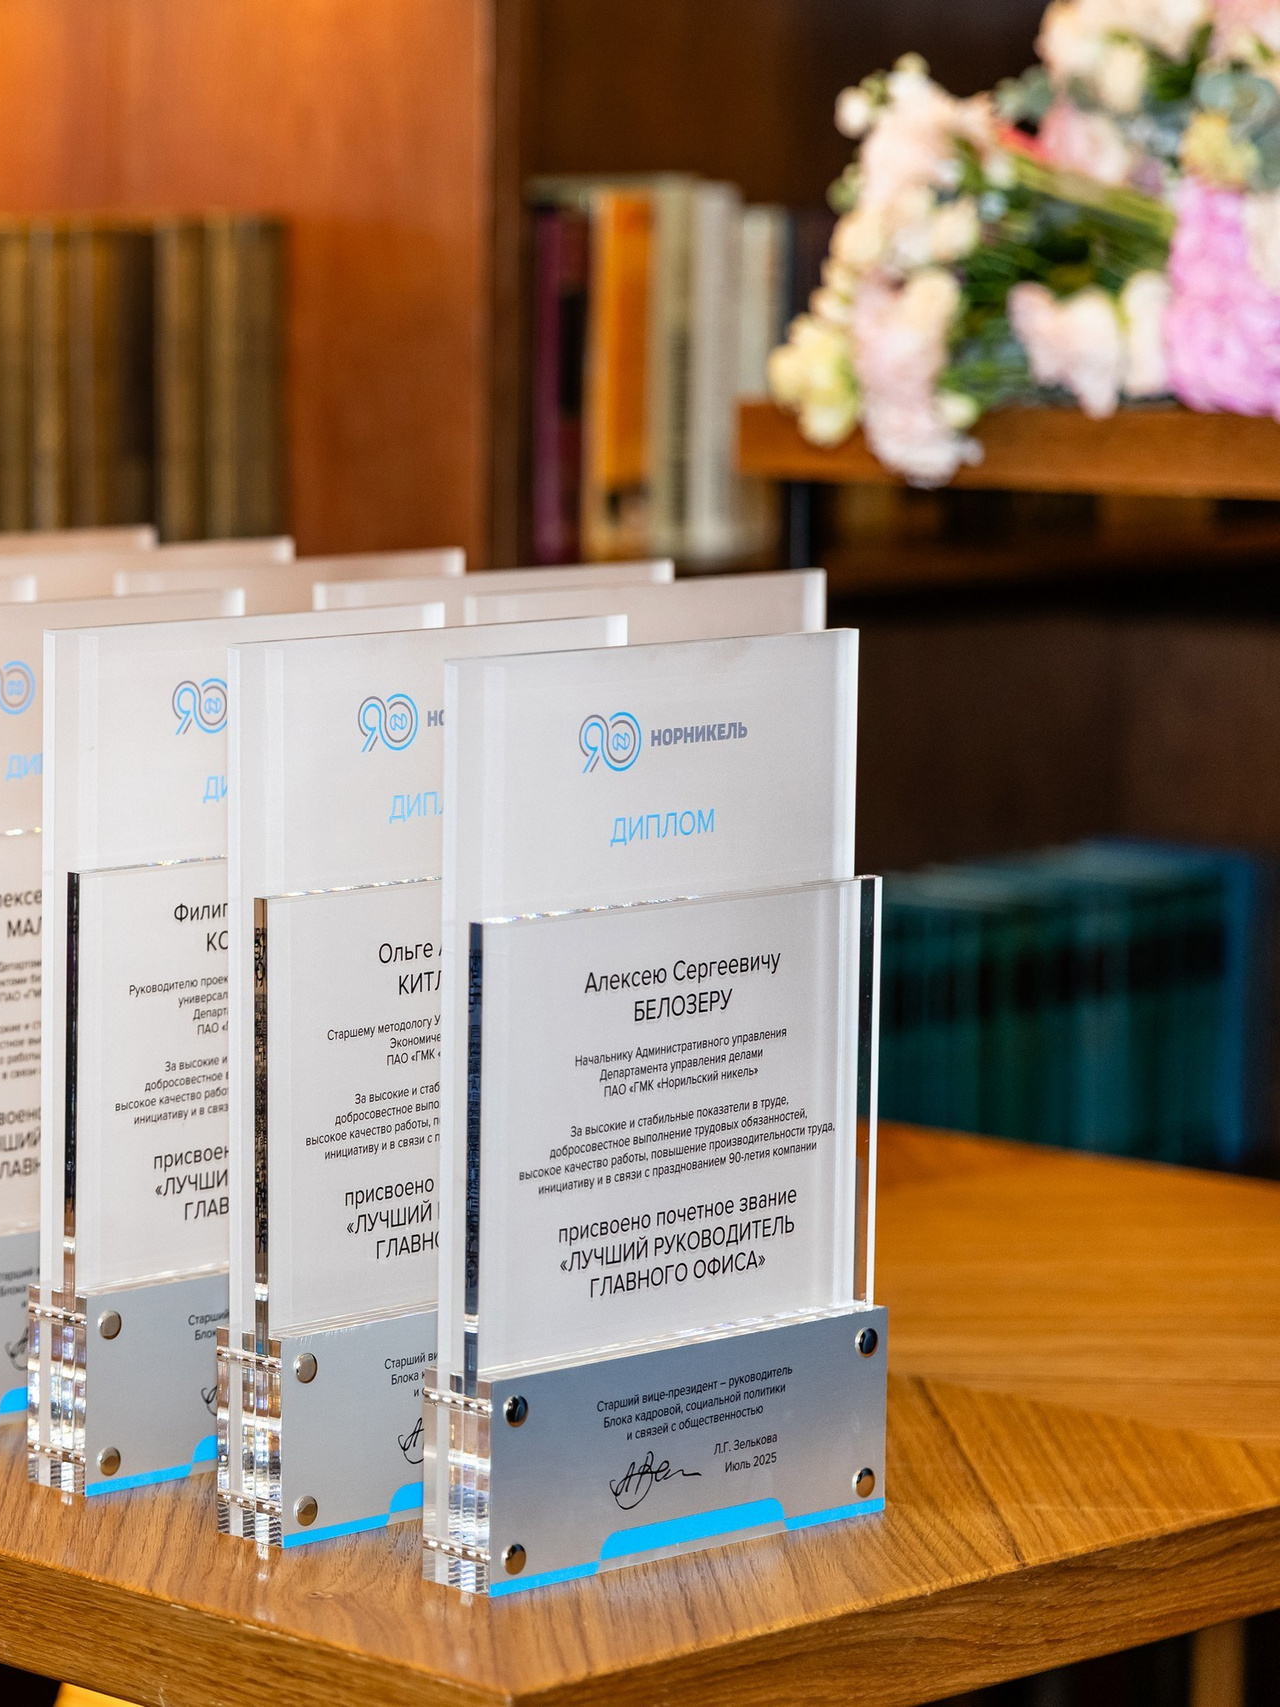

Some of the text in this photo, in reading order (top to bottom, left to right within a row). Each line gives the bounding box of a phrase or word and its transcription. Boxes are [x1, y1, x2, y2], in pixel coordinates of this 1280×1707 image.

[650, 721, 748, 747] НОРНИКЕЛЬ
[389, 791, 443, 824] ДИП
[609, 808, 715, 847] ДИПЛОМ
[379, 943, 433, 963] Ольге
[585, 954, 780, 992] Алексею Сергеевичу
[129, 979, 198, 996] Руководителю
[179, 991, 228, 1007] универсал
[635, 989, 732, 1021] БЕЛОЗЕРУ
[197, 1022, 219, 1034] ПАО
[327, 1019, 432, 1041] Старшему методологу
[387, 1049, 435, 1065] ПАО «ГМК
[575, 1029, 786, 1066] Начальнику Административного управления
[165, 1062, 176, 1071] За
[179, 1057, 219, 1069] высокие
[600, 1050, 763, 1081] Департамента управления делами
[145, 1073, 223, 1092] добросовестное
[604, 1068, 758, 1096] ПАО «ГМК «Норильский никель»
[115, 1099, 156, 1111] высокое
[159, 1092, 202, 1105] качество
[355, 1094, 366, 1104] За
[369, 1089, 409, 1102] высокие
[134, 1110, 188, 1124] инициативу
[335, 1105, 412, 1125] добросовестное
[571, 1096, 788, 1137] За высокие и стабильные показатели в труде,
[306, 1119, 430, 1145] высокое качество работы,
[550, 1108, 807, 1159] добросовестное выполнение трудовых обязанностей,
[325, 1144, 379, 1159] инициативу
[398, 1137, 424, 1148] связи
[427, 1135, 432, 1143] с
[519, 1123, 835, 1180] высокое качество работы, повышение производительности труда,
[539, 1179, 594, 1193] инициативу
[606, 1175, 611, 1184] в
[614, 1171, 642, 1181] связи
[645, 1169, 649, 1177] с
[653, 1157, 726, 1178] празднованием
[729, 1150, 770, 1163] 90-летия
[773, 1142, 816, 1156] компании
[156, 1169, 228, 1196] «ЛУЧШИ
[346, 1179, 434, 1209] присвоено
[185, 1197, 229, 1219] ГЛАВ
[347, 1200, 431, 1233] «ЛУЧШИЙ
[559, 1190, 796, 1245] присвоено почетное звание
[561, 1216, 794, 1271] «ЛУЧШИЙ РУКОВОДИТЕЛЬ
[591, 1251, 765, 1297] ГЛАВНОГО ОФИСА»
[385, 1353, 425, 1369] Старший
[392, 1373, 419, 1385] Блока
[597, 1395, 639, 1412] Старший
[642, 1381, 717, 1403] вице-президент
[729, 1367, 792, 1388] руководитель
[604, 1385, 785, 1427] Блока кадровой, социальной политики
[635, 1423, 668, 1438] связей
[671, 1423, 676, 1431] с
[679, 1406, 763, 1429] общественностью
[714, 1434, 777, 1454] Л.Г. Зелькова
[725, 1452, 776, 1472] Июль 2025
